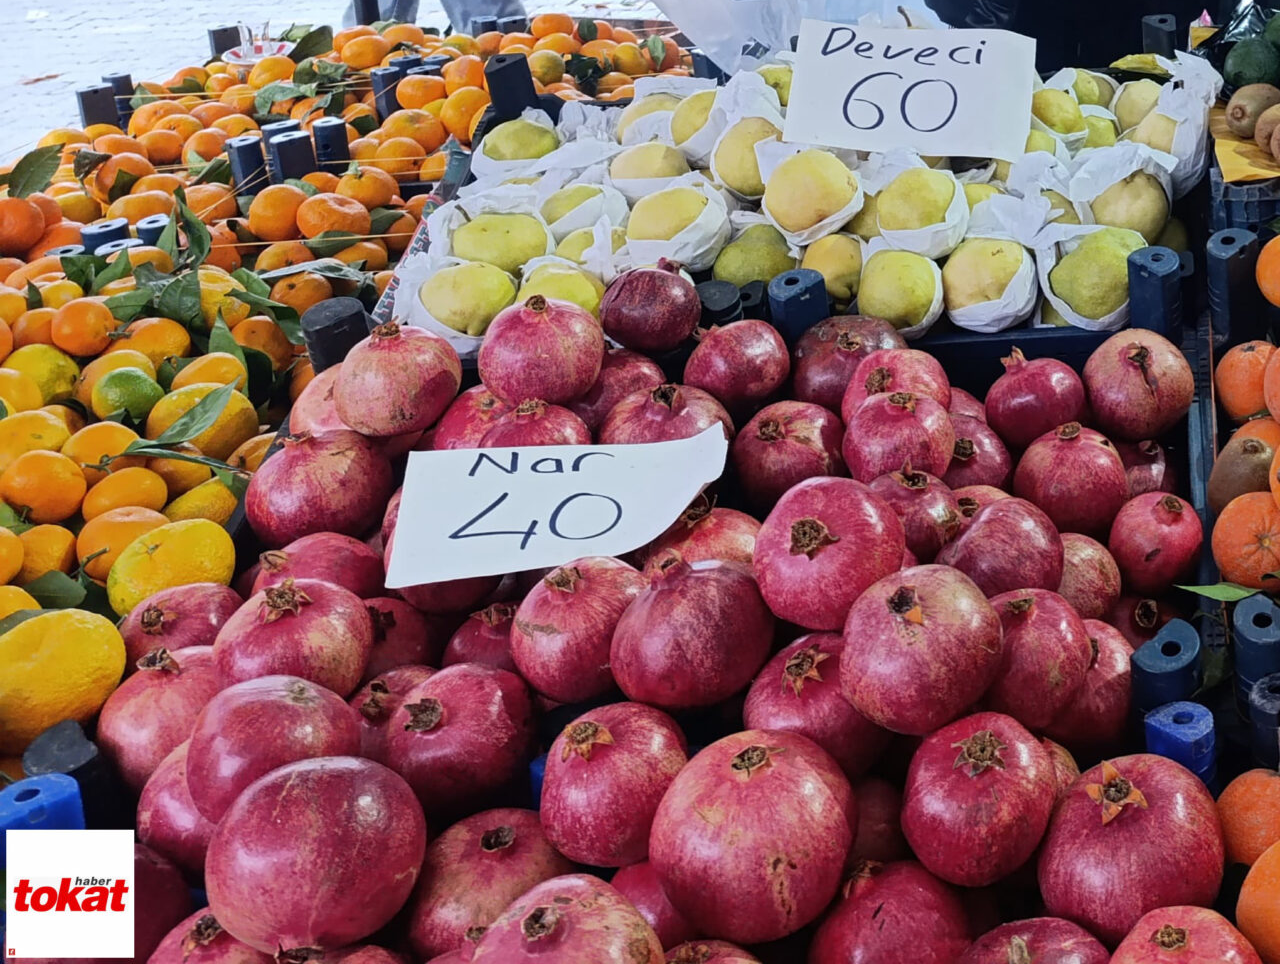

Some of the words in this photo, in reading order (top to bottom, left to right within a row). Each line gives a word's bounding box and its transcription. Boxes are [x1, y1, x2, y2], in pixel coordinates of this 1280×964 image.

[821, 26, 986, 67] Deveci
[843, 71, 958, 133] 60
[468, 451, 614, 478] Nar
[449, 492, 623, 551] 40
